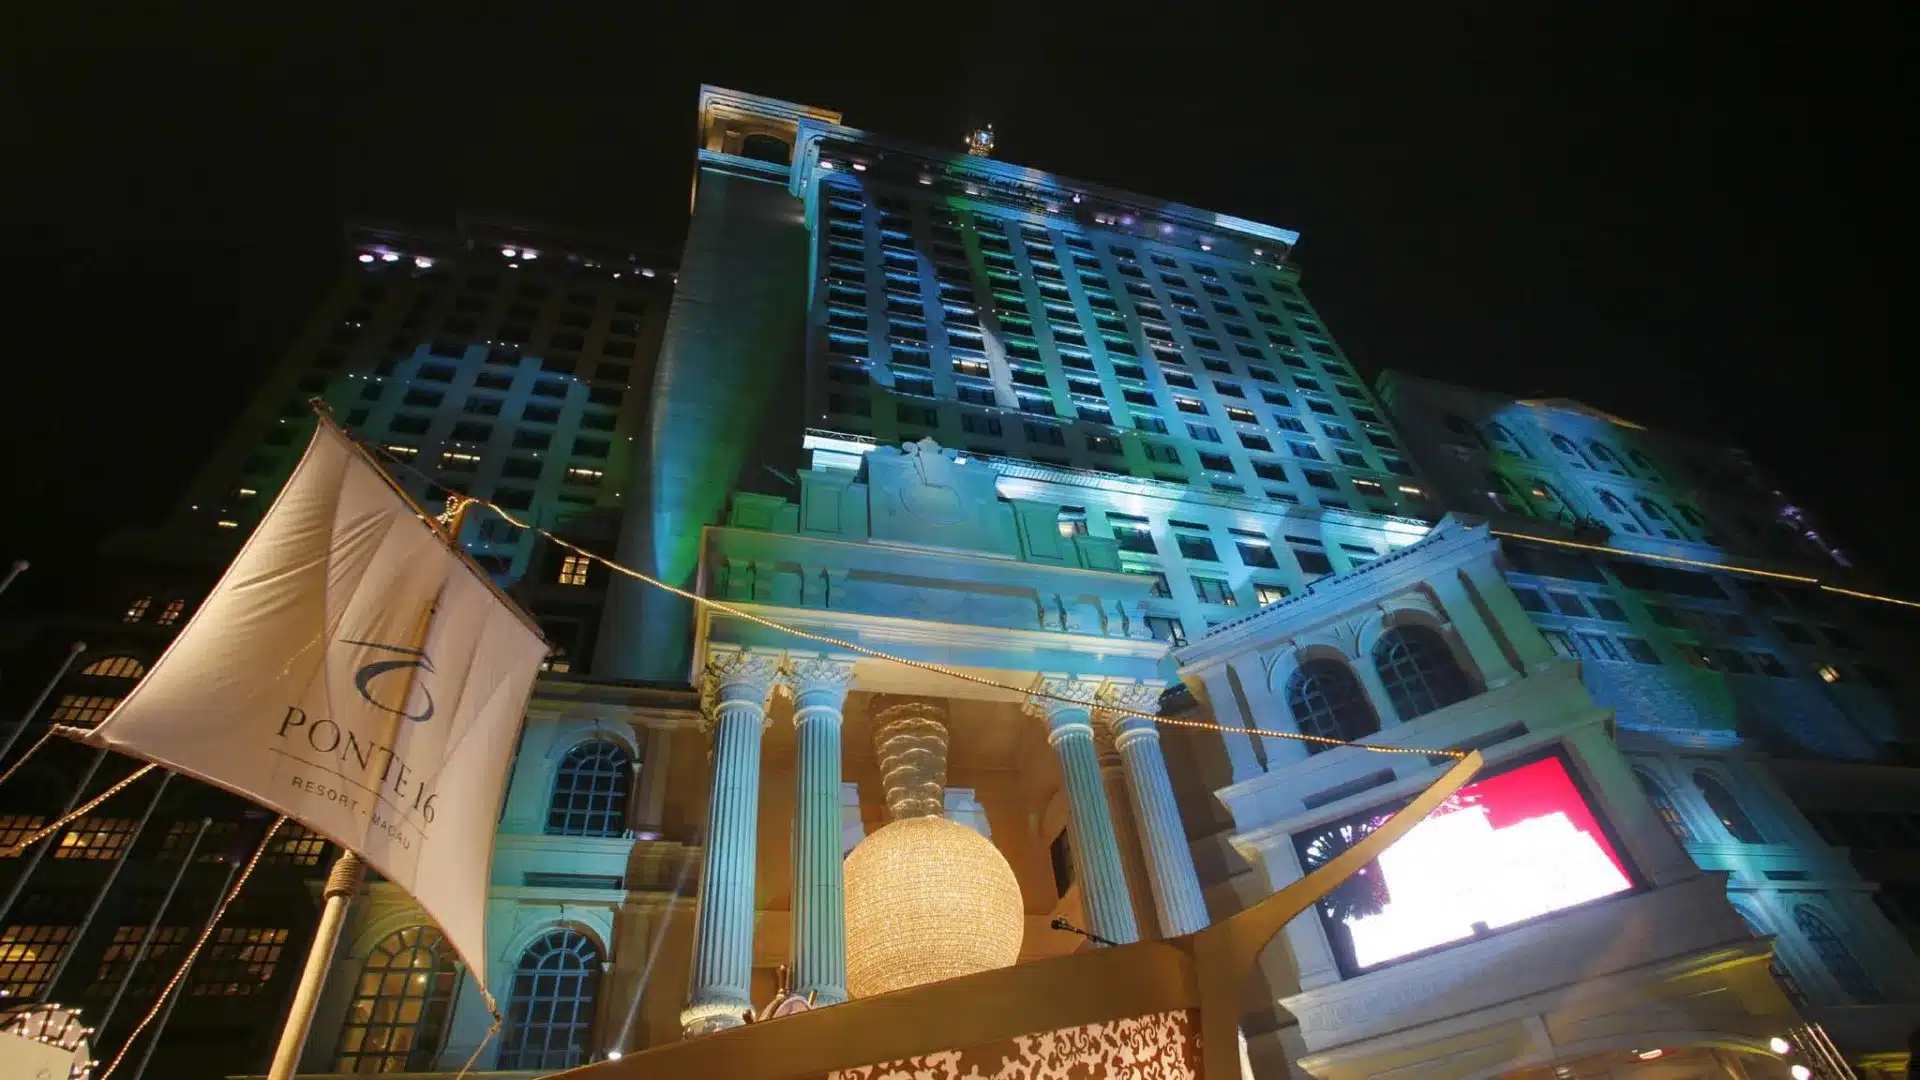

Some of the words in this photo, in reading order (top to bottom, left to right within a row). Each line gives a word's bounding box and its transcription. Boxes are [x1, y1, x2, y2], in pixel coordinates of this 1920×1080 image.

[276, 706, 412, 797] PONTE
[413, 781, 438, 823] 16
[291, 776, 359, 812] RESORT
[371, 813, 411, 850] MACAU
